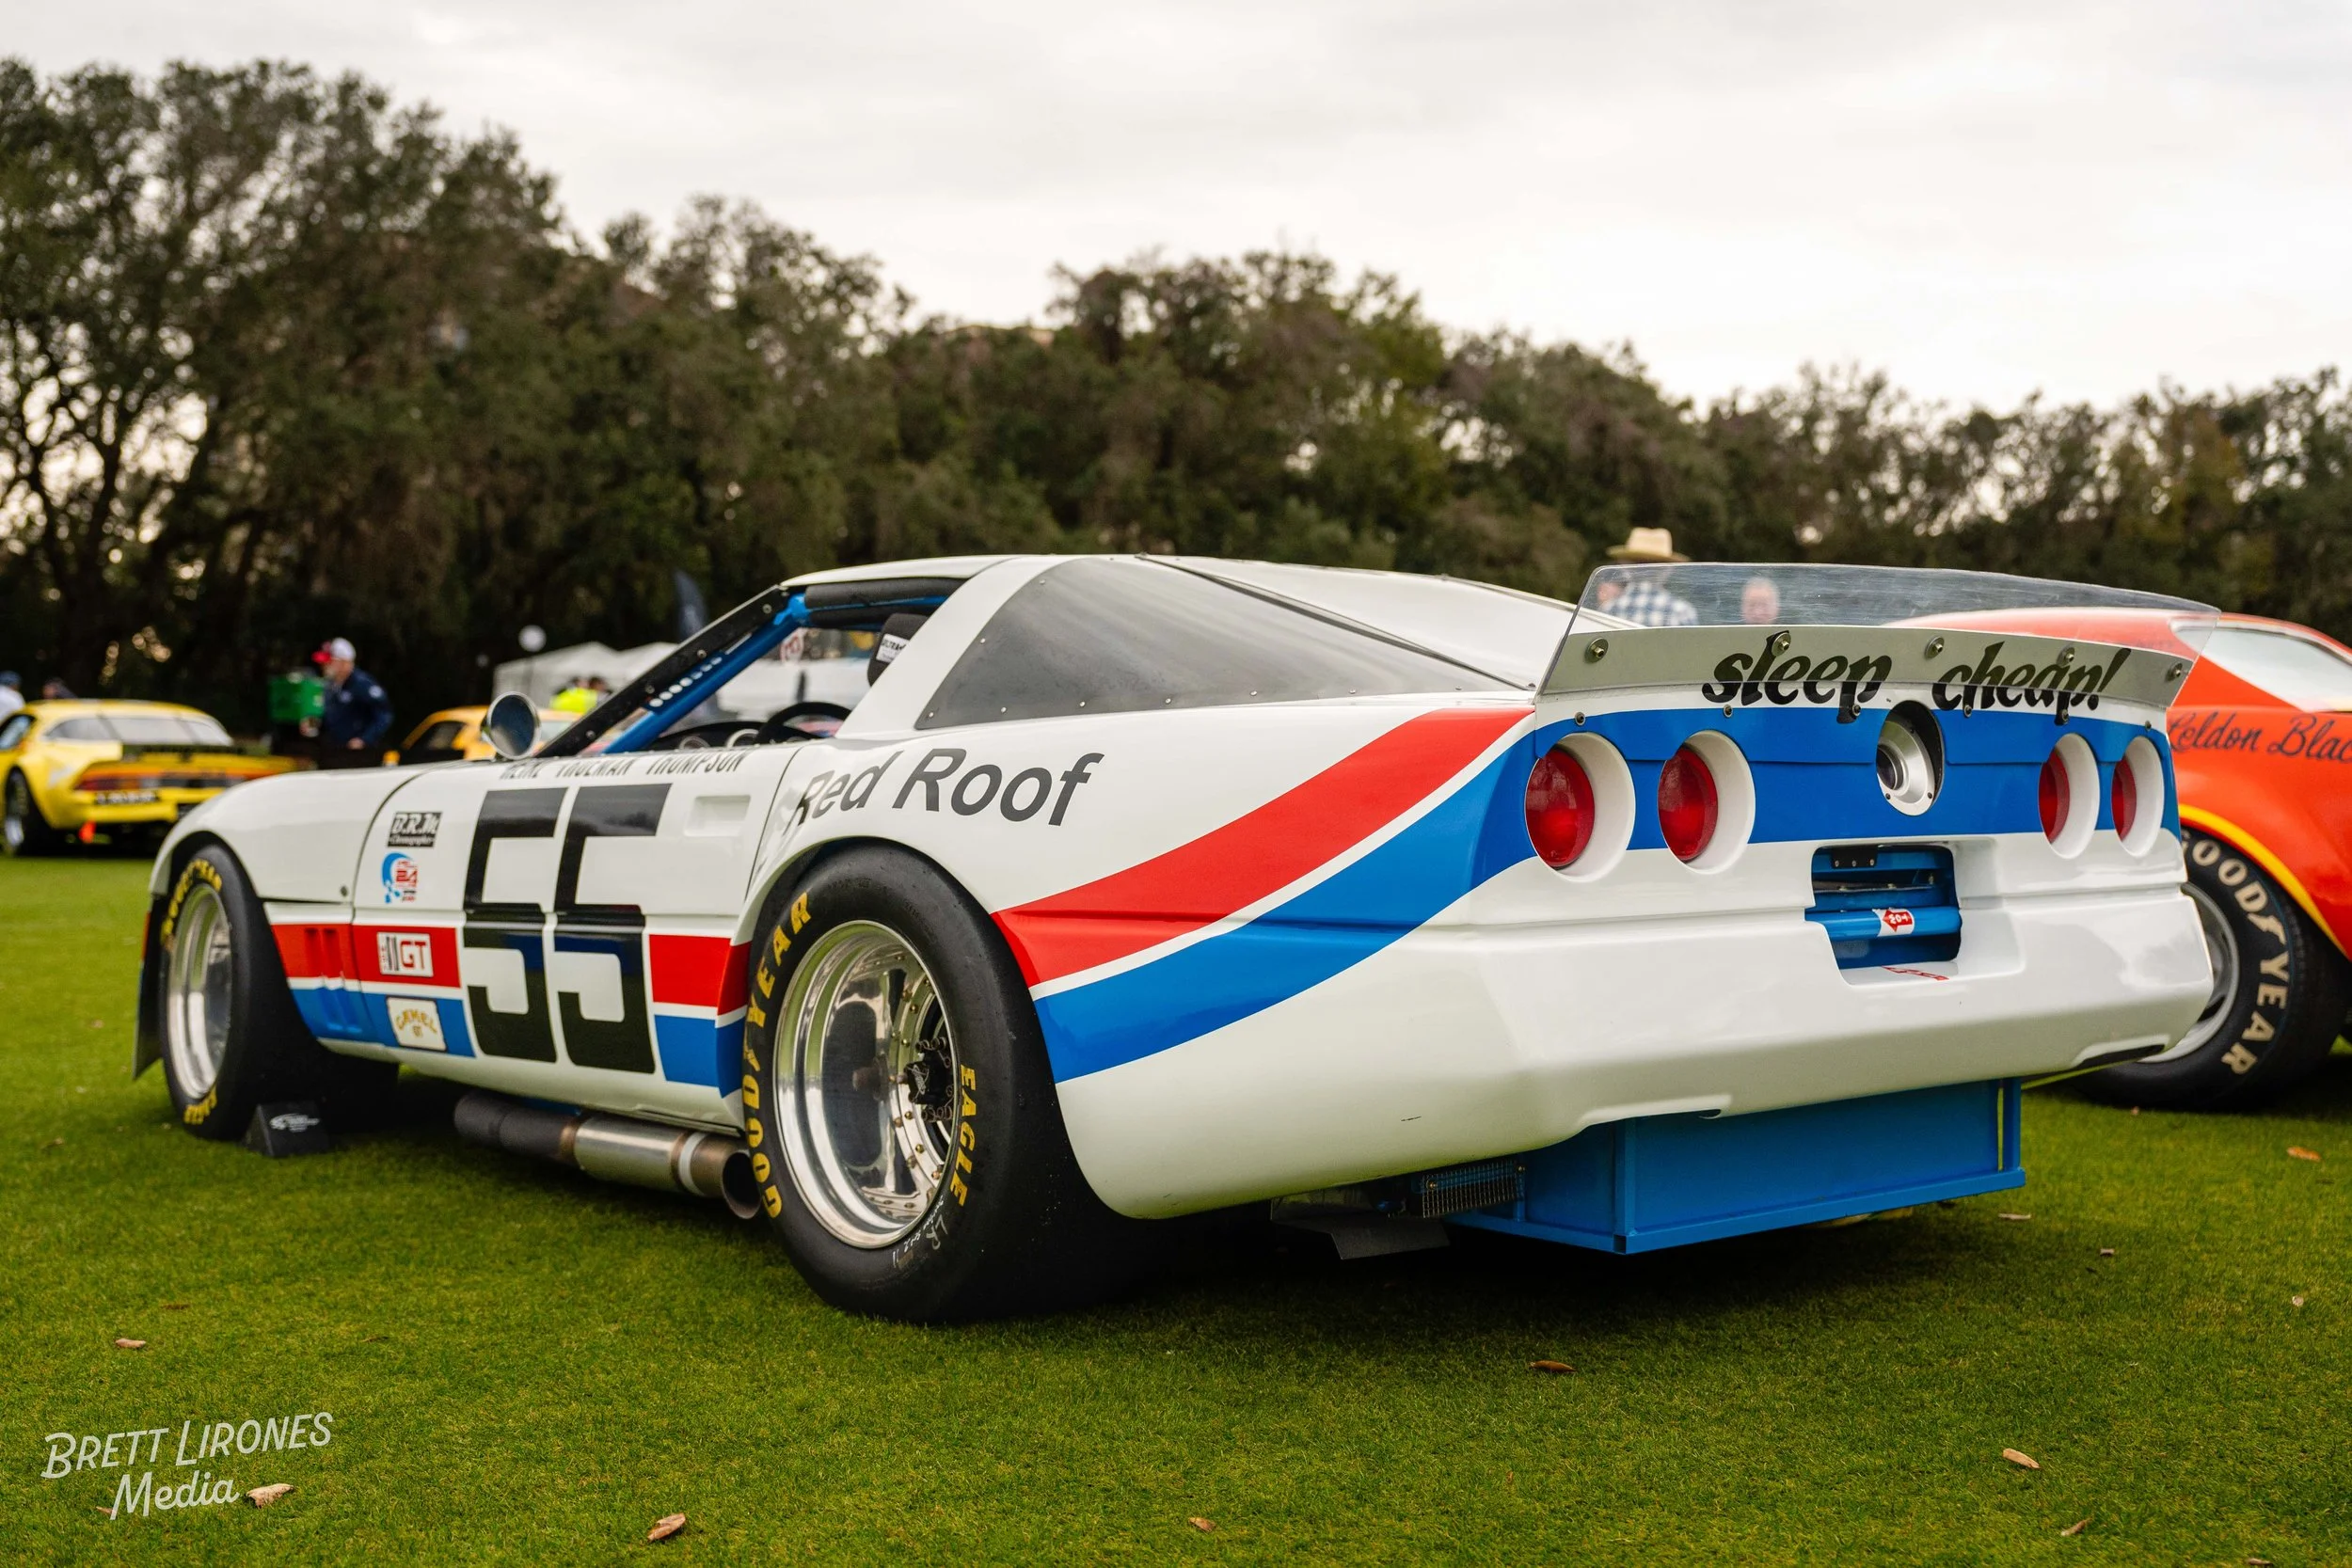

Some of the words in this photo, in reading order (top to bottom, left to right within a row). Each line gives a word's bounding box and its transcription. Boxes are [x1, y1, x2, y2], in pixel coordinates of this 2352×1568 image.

[1701, 629, 1893, 724] sleep
[1931, 641, 2132, 726] cheap!
[783, 751, 904, 835] Red
[892, 748, 1104, 827] Roof
[463, 783, 673, 1074] 55
[395, 1008, 437, 1033] CAMEL
[743, 892, 811, 1219] GOODYEAR
[950, 1064, 977, 1207] EAGLE
